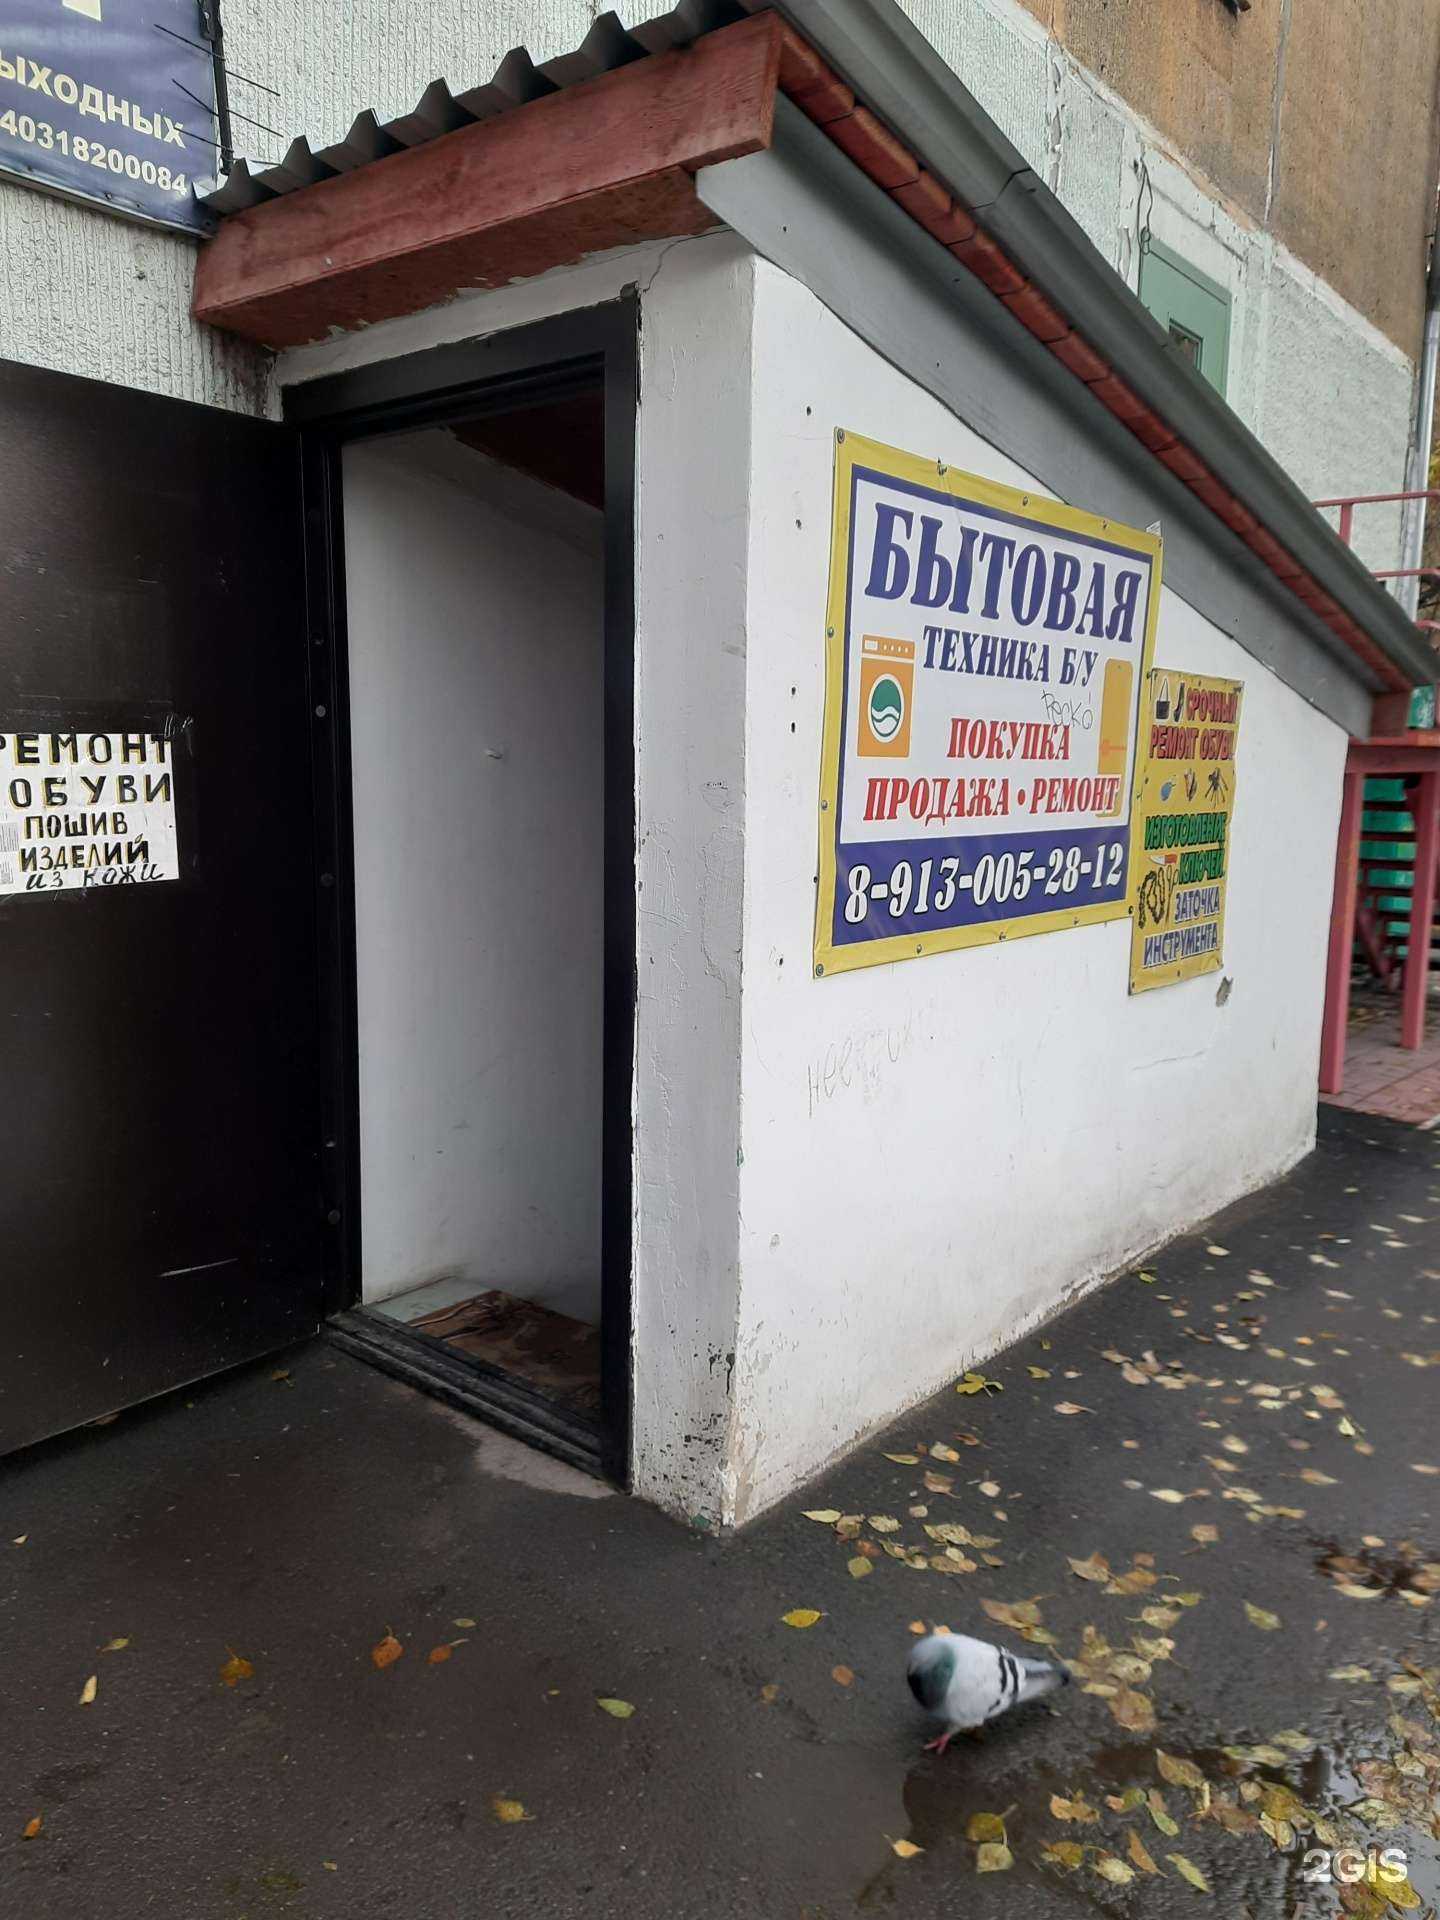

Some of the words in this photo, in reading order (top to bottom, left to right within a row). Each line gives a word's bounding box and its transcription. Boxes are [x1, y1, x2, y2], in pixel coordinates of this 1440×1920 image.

[0, 109, 188, 196] 40318200084
[864, 502, 1142, 643] БЫТОВАЯ
[923, 625, 1050, 684] ТЕХНИКА
[1059, 647, 1099, 688] Б/У
[947, 717, 1071, 760] ПОКУПКА
[1149, 724, 1199, 760] РЕМОНТ
[9, 772, 171, 809] ОБУВИ
[862, 777, 1010, 827] ПРОДАЖА
[1028, 777, 1121, 815] РЕМОНТ
[25, 811, 128, 839] ПОШИВ
[19, 833, 149, 873] ИЗДЕЛИЙ
[843, 842, 1125, 924] 8-913-005-28-12
[1174, 886, 1221, 922] ЗАТОЧКА
[1143, 921, 1219, 968] ИНСТРУМЕНТА
